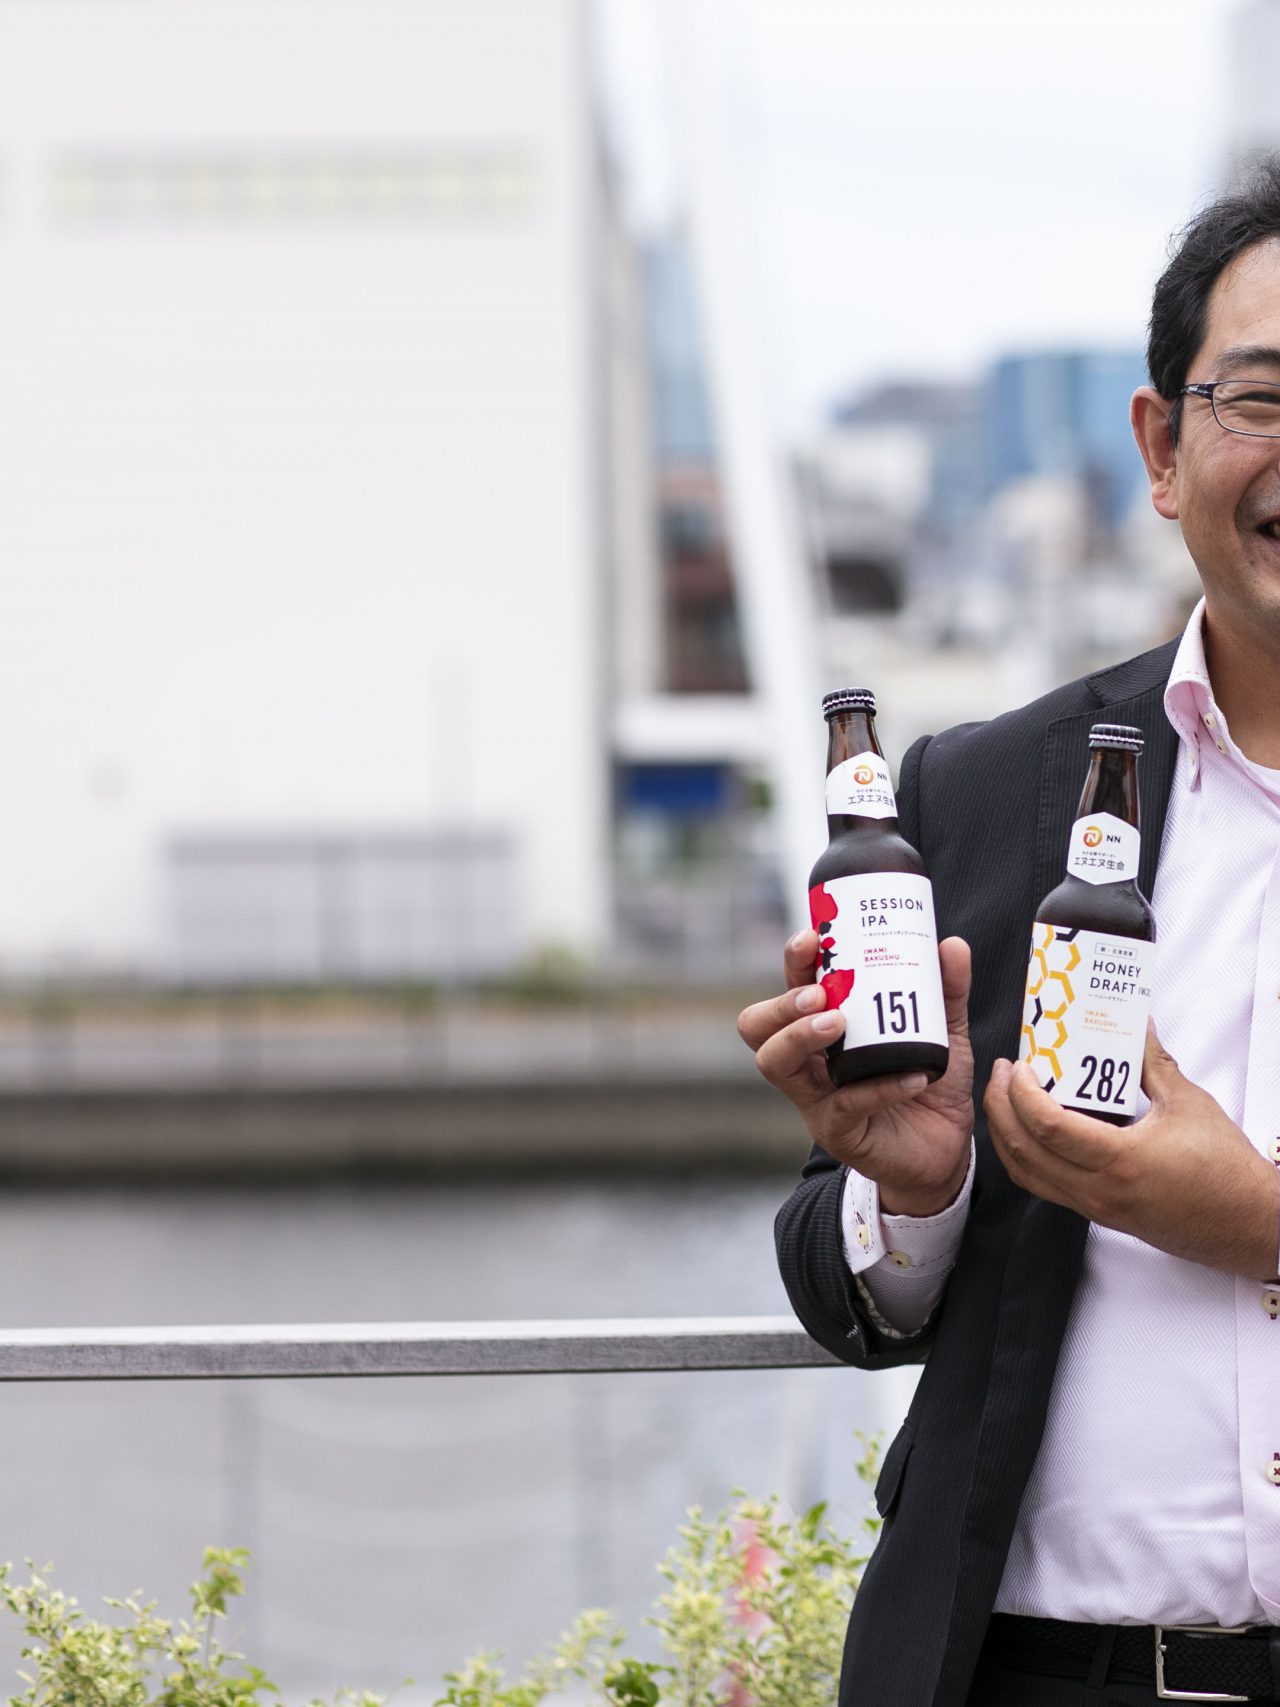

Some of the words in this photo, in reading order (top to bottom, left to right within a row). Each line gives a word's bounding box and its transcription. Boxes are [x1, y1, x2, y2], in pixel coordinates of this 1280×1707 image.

[1106, 835, 1121, 843] NN
[1074, 857, 1125, 871] エヌエヌ生命
[860, 898, 923, 911] SESSION
[862, 915, 887, 927] IPA
[865, 954, 900, 962] BAKUSHU
[1093, 960, 1141, 978] HONEY
[1090, 977, 1136, 995] DRAFT
[873, 991, 919, 1034] 151
[1076, 1055, 1130, 1105] 282
